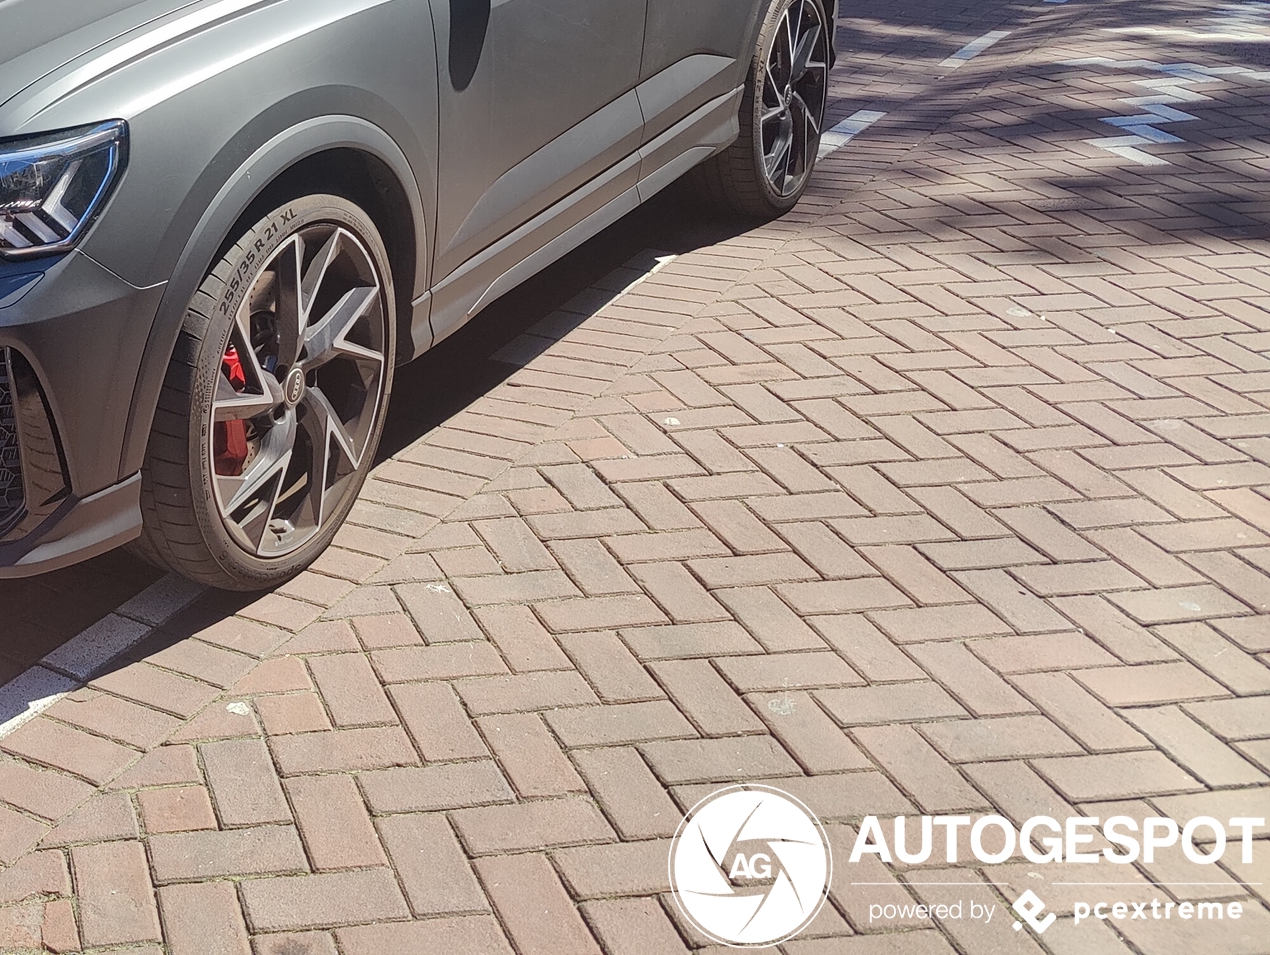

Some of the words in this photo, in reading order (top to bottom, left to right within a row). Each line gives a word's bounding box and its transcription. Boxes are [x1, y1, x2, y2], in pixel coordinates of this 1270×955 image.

[219, 247, 256, 316] 255/35
[254, 237, 267, 254] R
[264, 222, 280, 242] 21
[280, 207, 299, 226] XL
